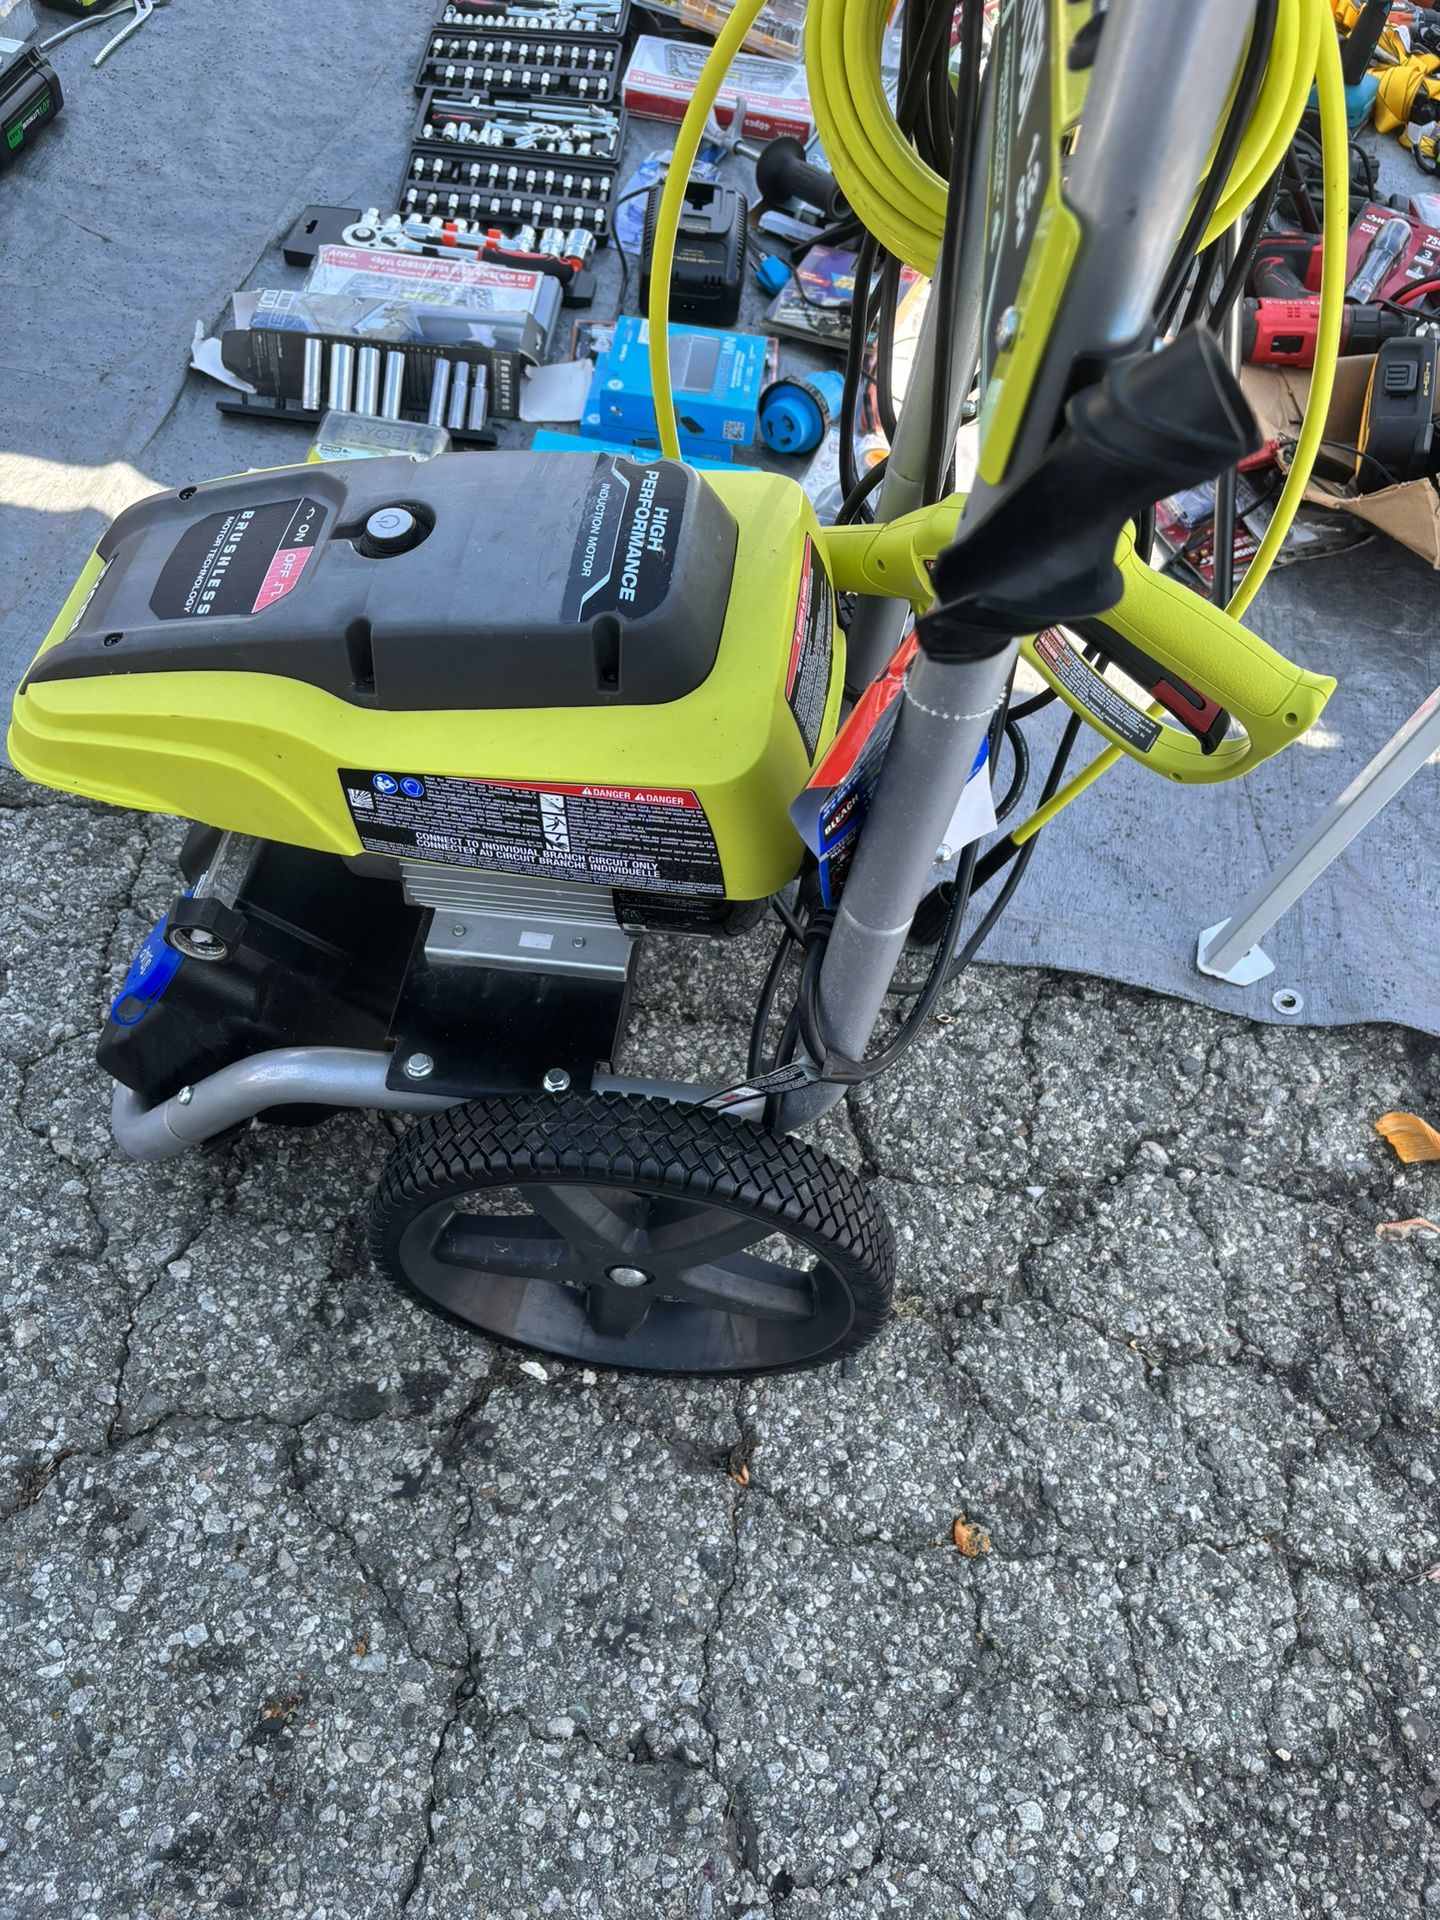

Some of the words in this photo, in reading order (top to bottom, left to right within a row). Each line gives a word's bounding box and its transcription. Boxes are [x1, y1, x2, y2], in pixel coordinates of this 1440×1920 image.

[498, 358, 511, 412] Features
[349, 423, 411, 444] RYOBI
[590, 482, 611, 535] INDUCTION
[647, 506, 670, 553] HIGH
[212, 516, 235, 547] MOTOR
[293, 524, 310, 542] ON
[618, 470, 660, 602] PERFORMANCE
[196, 510, 256, 615] BRUSHLESS
[279, 552, 296, 579] OFF
[581, 535, 598, 577] MOTOR
[183, 547, 218, 613] TECHNOLOGY
[592, 787, 631, 800] DANGER
[646, 793, 684, 805] DANGER
[824, 793, 859, 835] BLEACH
[415, 831, 463, 847] CONNECT
[465, 838, 479, 848] TO
[481, 841, 540, 857] INDIVIDUAL
[542, 850, 586, 863] BRANCH
[588, 856, 629, 868] CIRCUIT
[631, 860, 659, 871] ONLY
[416, 838, 477, 855] CONNECTER
[479, 848, 494, 857] AU
[495, 850, 536, 863] CIRCUIT
[539, 857, 588, 870] BRANCHE
[590, 864, 661, 878] INDIVIDUELLE
